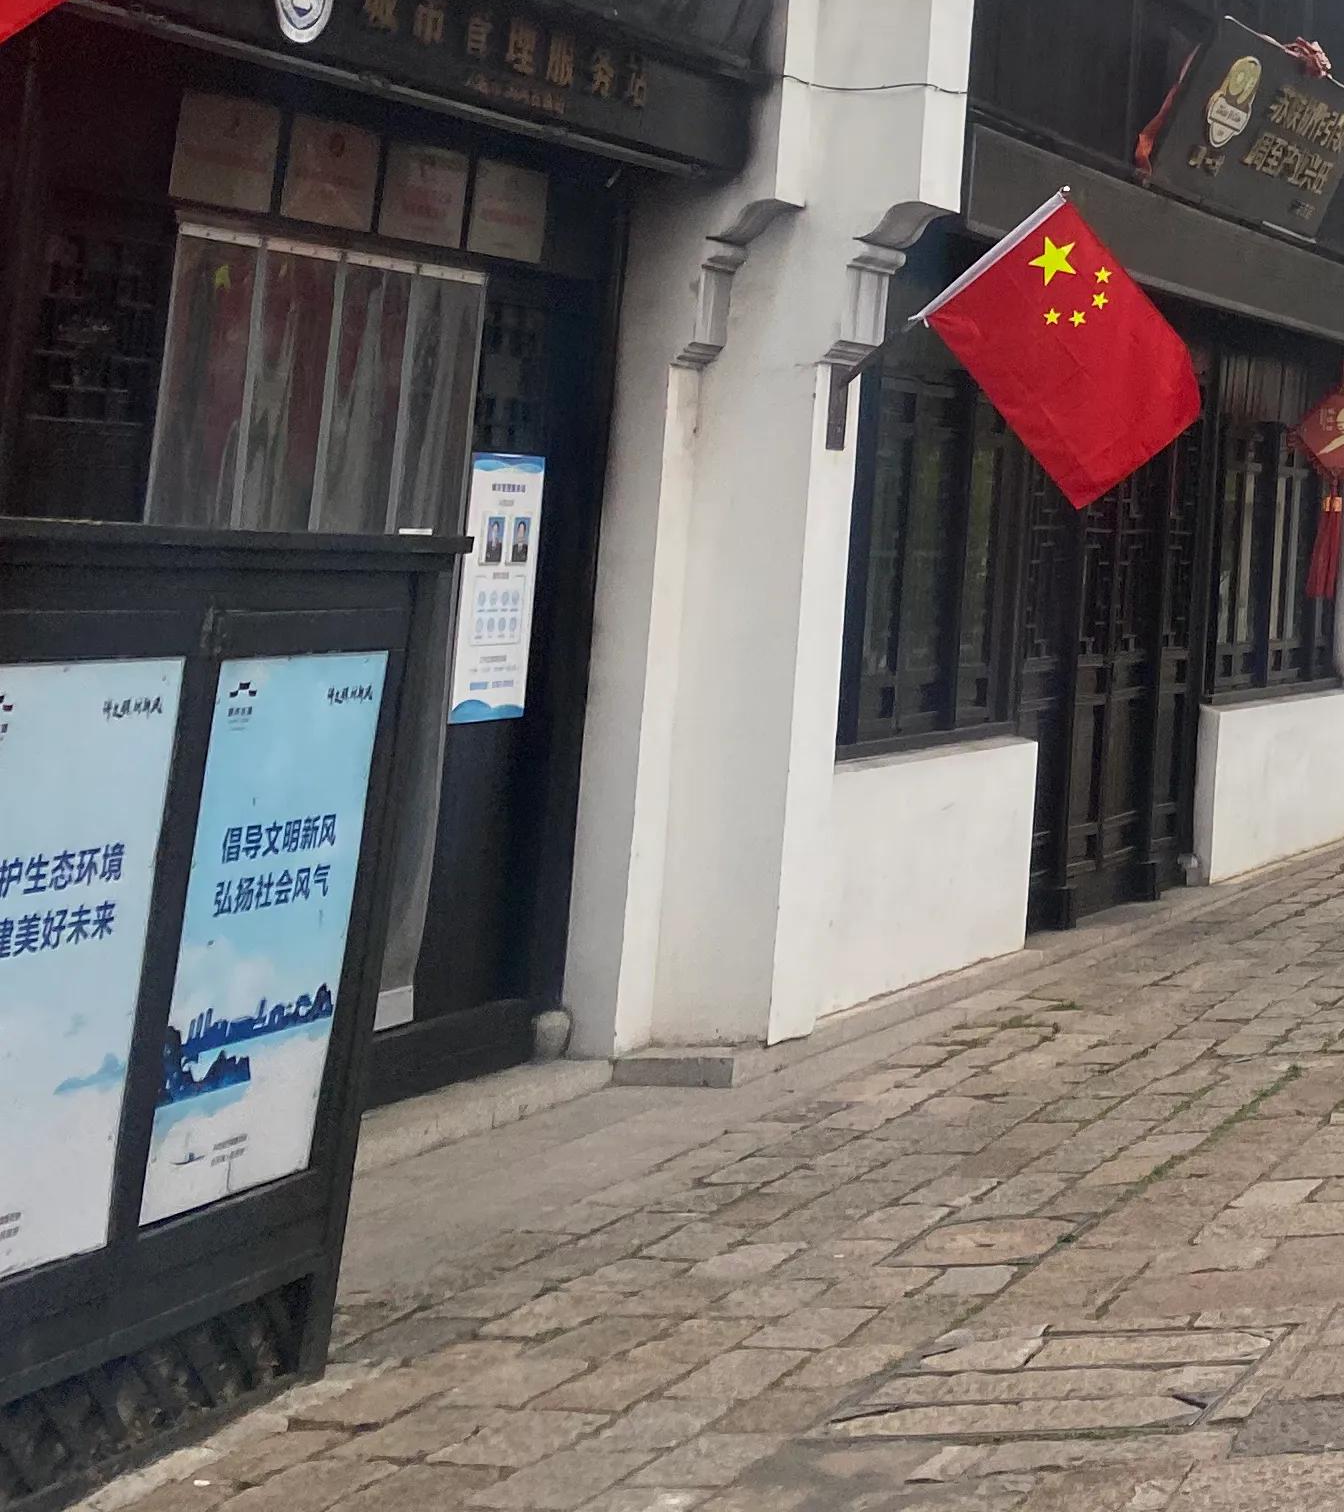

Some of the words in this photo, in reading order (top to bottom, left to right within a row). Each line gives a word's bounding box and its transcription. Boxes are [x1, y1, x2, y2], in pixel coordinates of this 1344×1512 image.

[222, 814, 337, 864] 倡导文明新风
[212, 864, 331, 918] 弘扬社会风气
